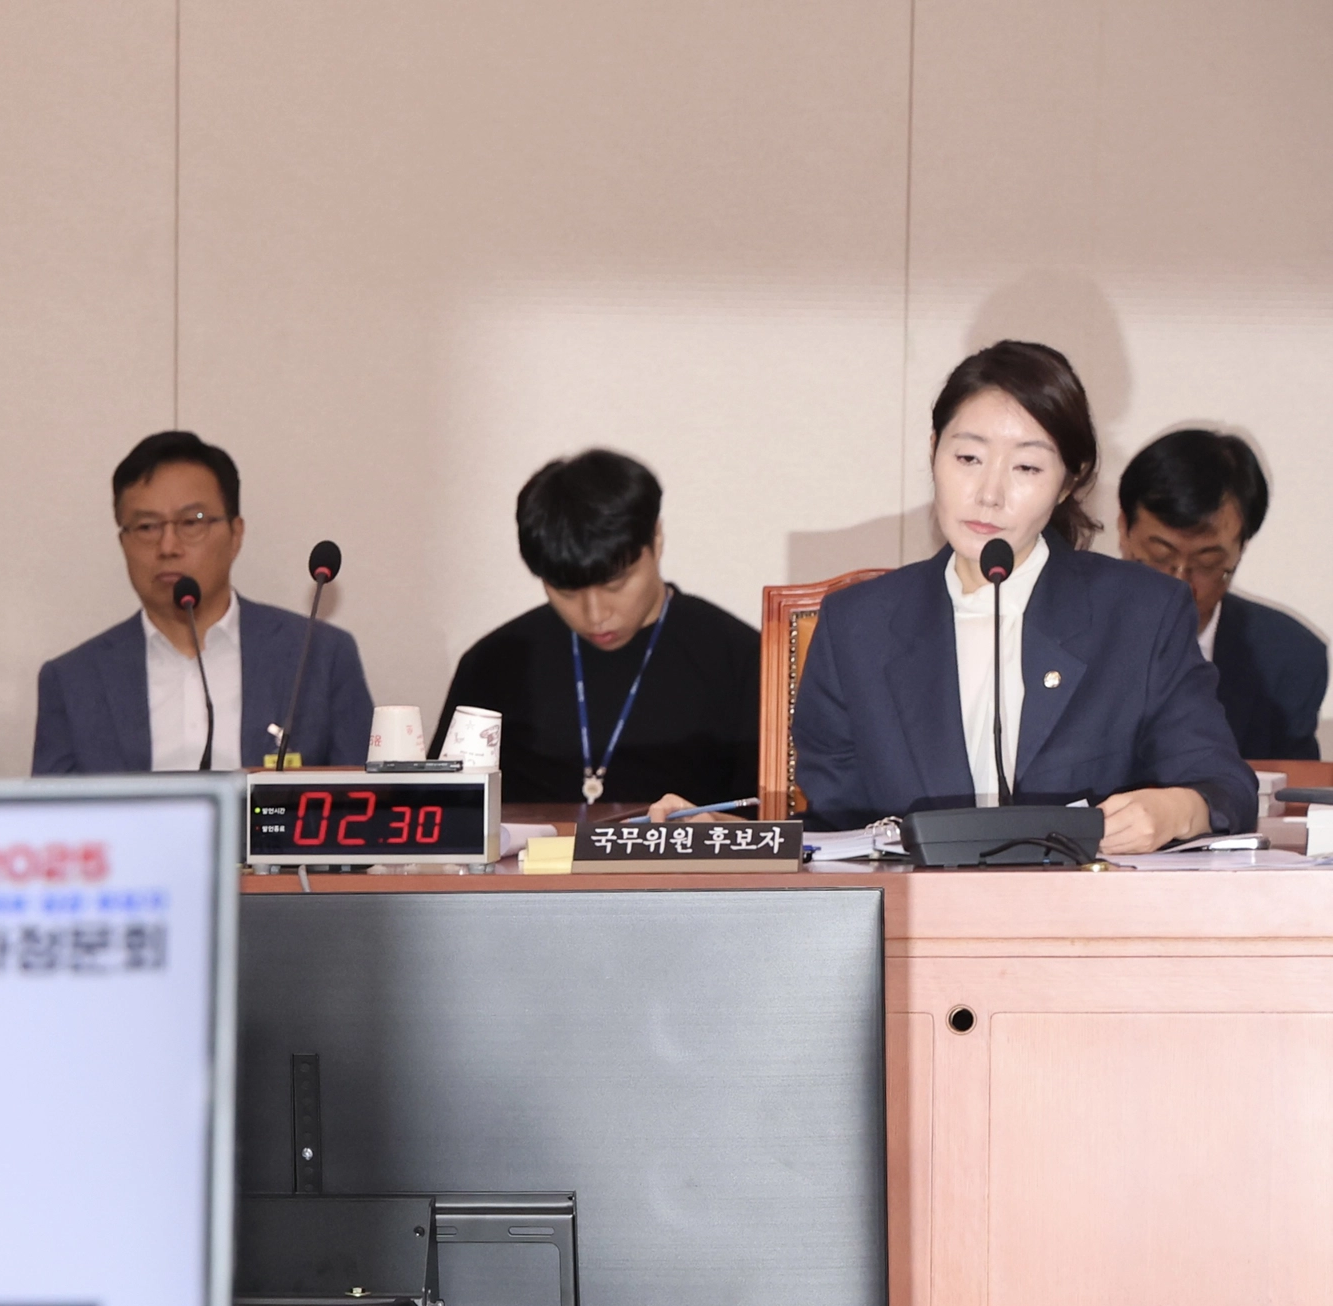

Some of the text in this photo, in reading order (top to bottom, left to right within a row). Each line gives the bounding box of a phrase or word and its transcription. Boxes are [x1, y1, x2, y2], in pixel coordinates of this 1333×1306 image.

[293, 791, 376, 846] 02
[590, 826, 785, 854] 국무위원 후보자
